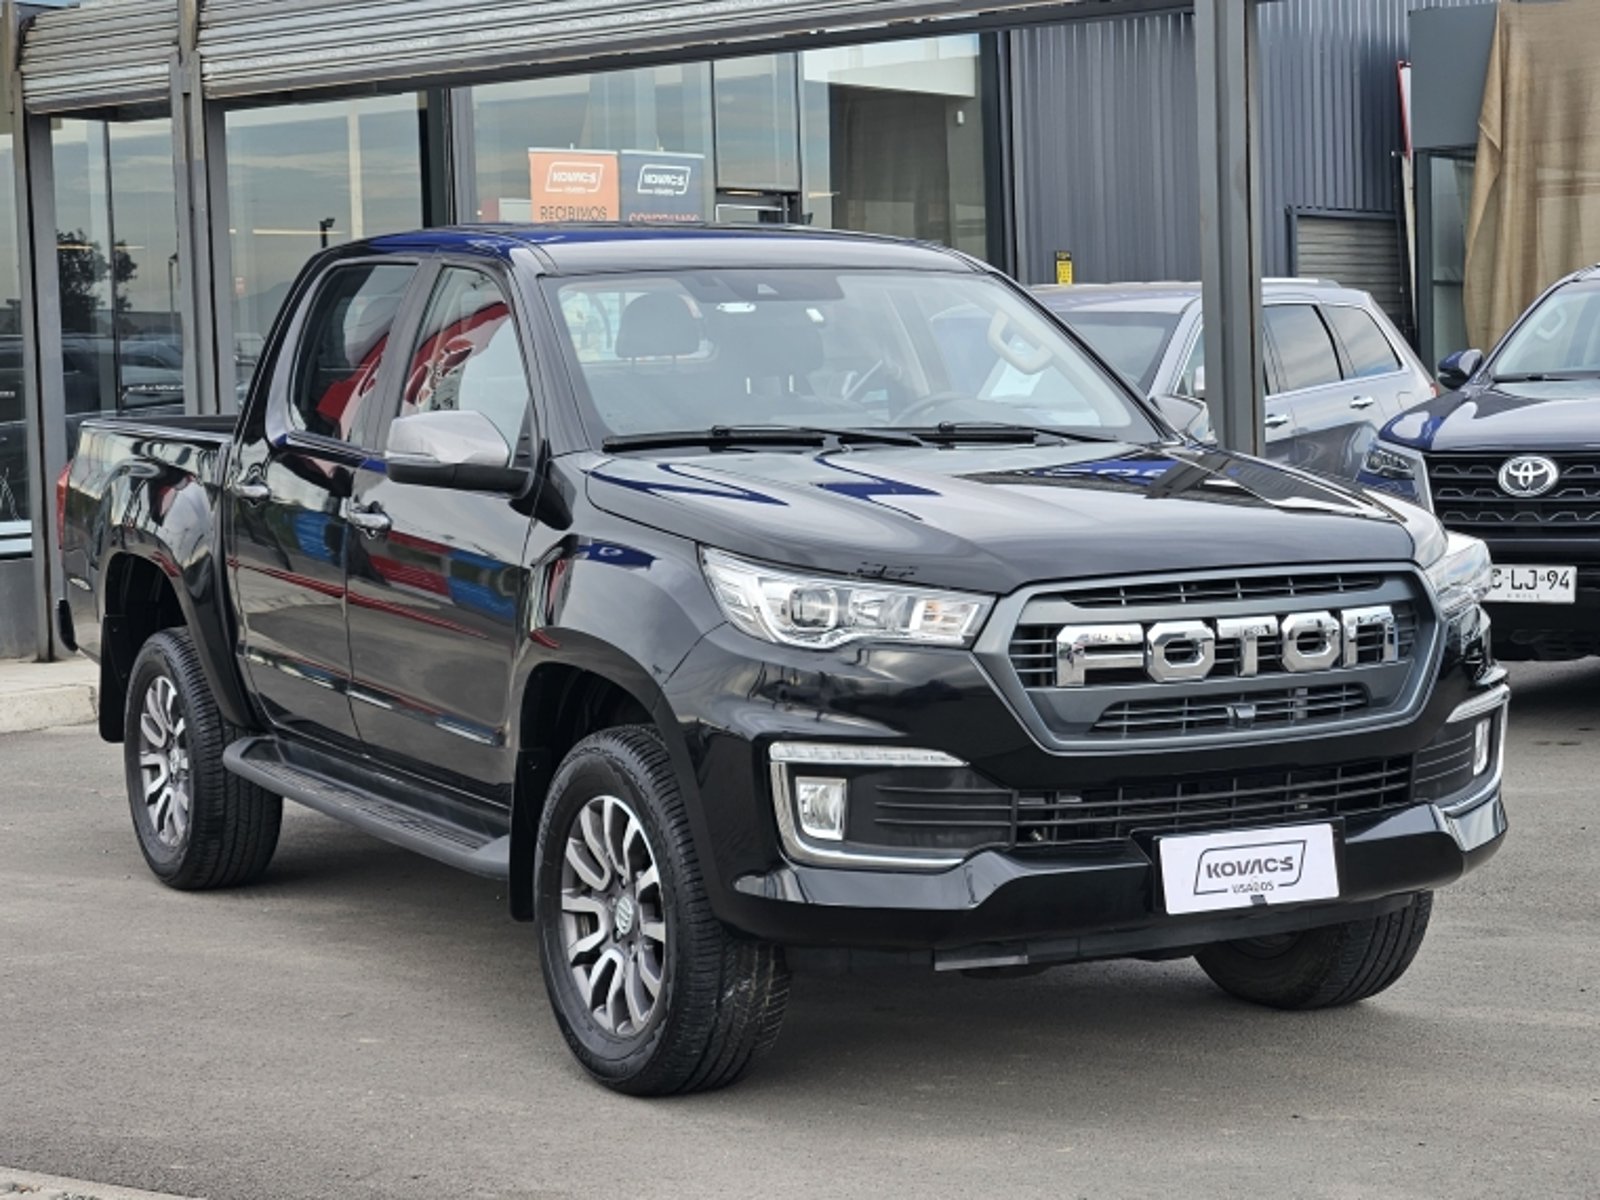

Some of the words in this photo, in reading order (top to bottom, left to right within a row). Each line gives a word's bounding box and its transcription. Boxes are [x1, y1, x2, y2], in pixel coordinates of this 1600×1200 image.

[540, 205, 608, 220] RECIBIMOS
[1056, 605, 1399, 688] FOTON
[1206, 856, 1294, 879] KOVACS
